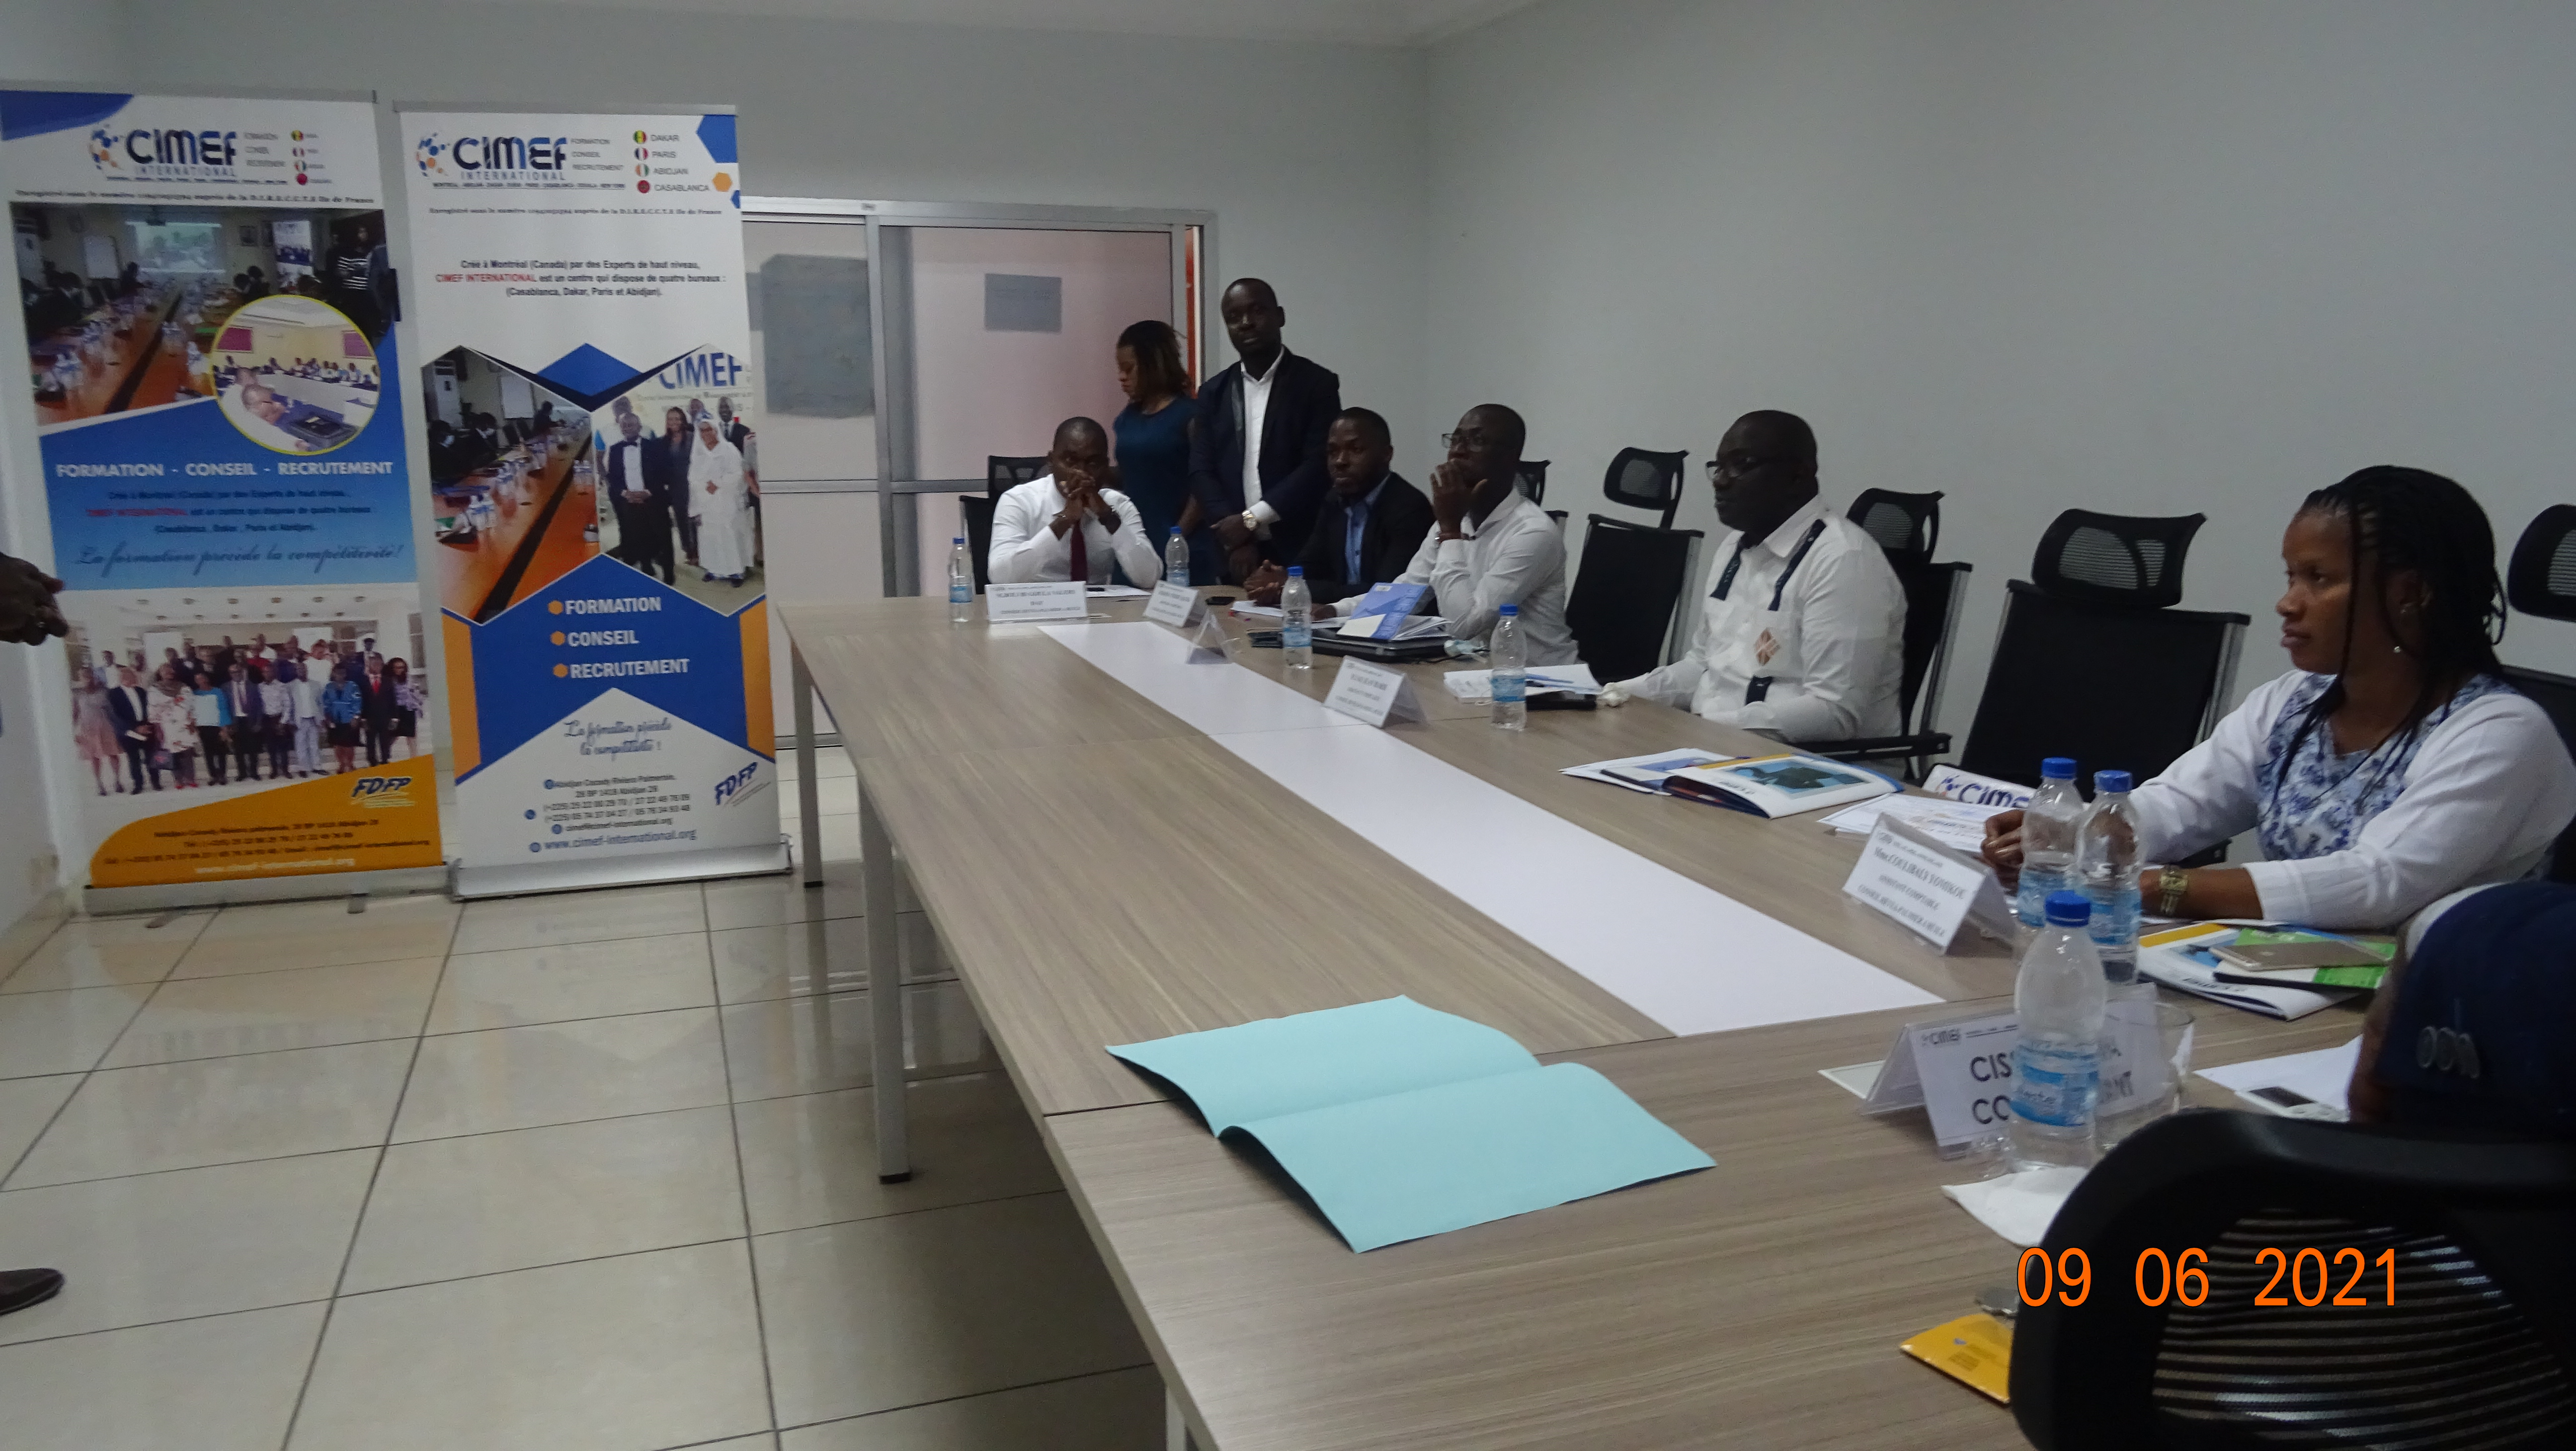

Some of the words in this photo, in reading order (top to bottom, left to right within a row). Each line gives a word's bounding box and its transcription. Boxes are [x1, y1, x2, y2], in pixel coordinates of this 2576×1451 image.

[126, 129, 237, 165] CIMEF
[453, 137, 567, 170] CIMEF
[460, 171, 566, 180] INTERNATIONAL
[466, 273, 537, 282] INTERNATIONAL
[56, 464, 164, 477] FORMATION
[185, 463, 258, 476] CONSEIL
[278, 462, 394, 475] RECRUTEMENT
[564, 597, 662, 615] FORMATION
[567, 630, 640, 647] CONSEIL
[569, 658, 690, 679] RECRUTEMENT
[351, 777, 412, 798] FDFP
